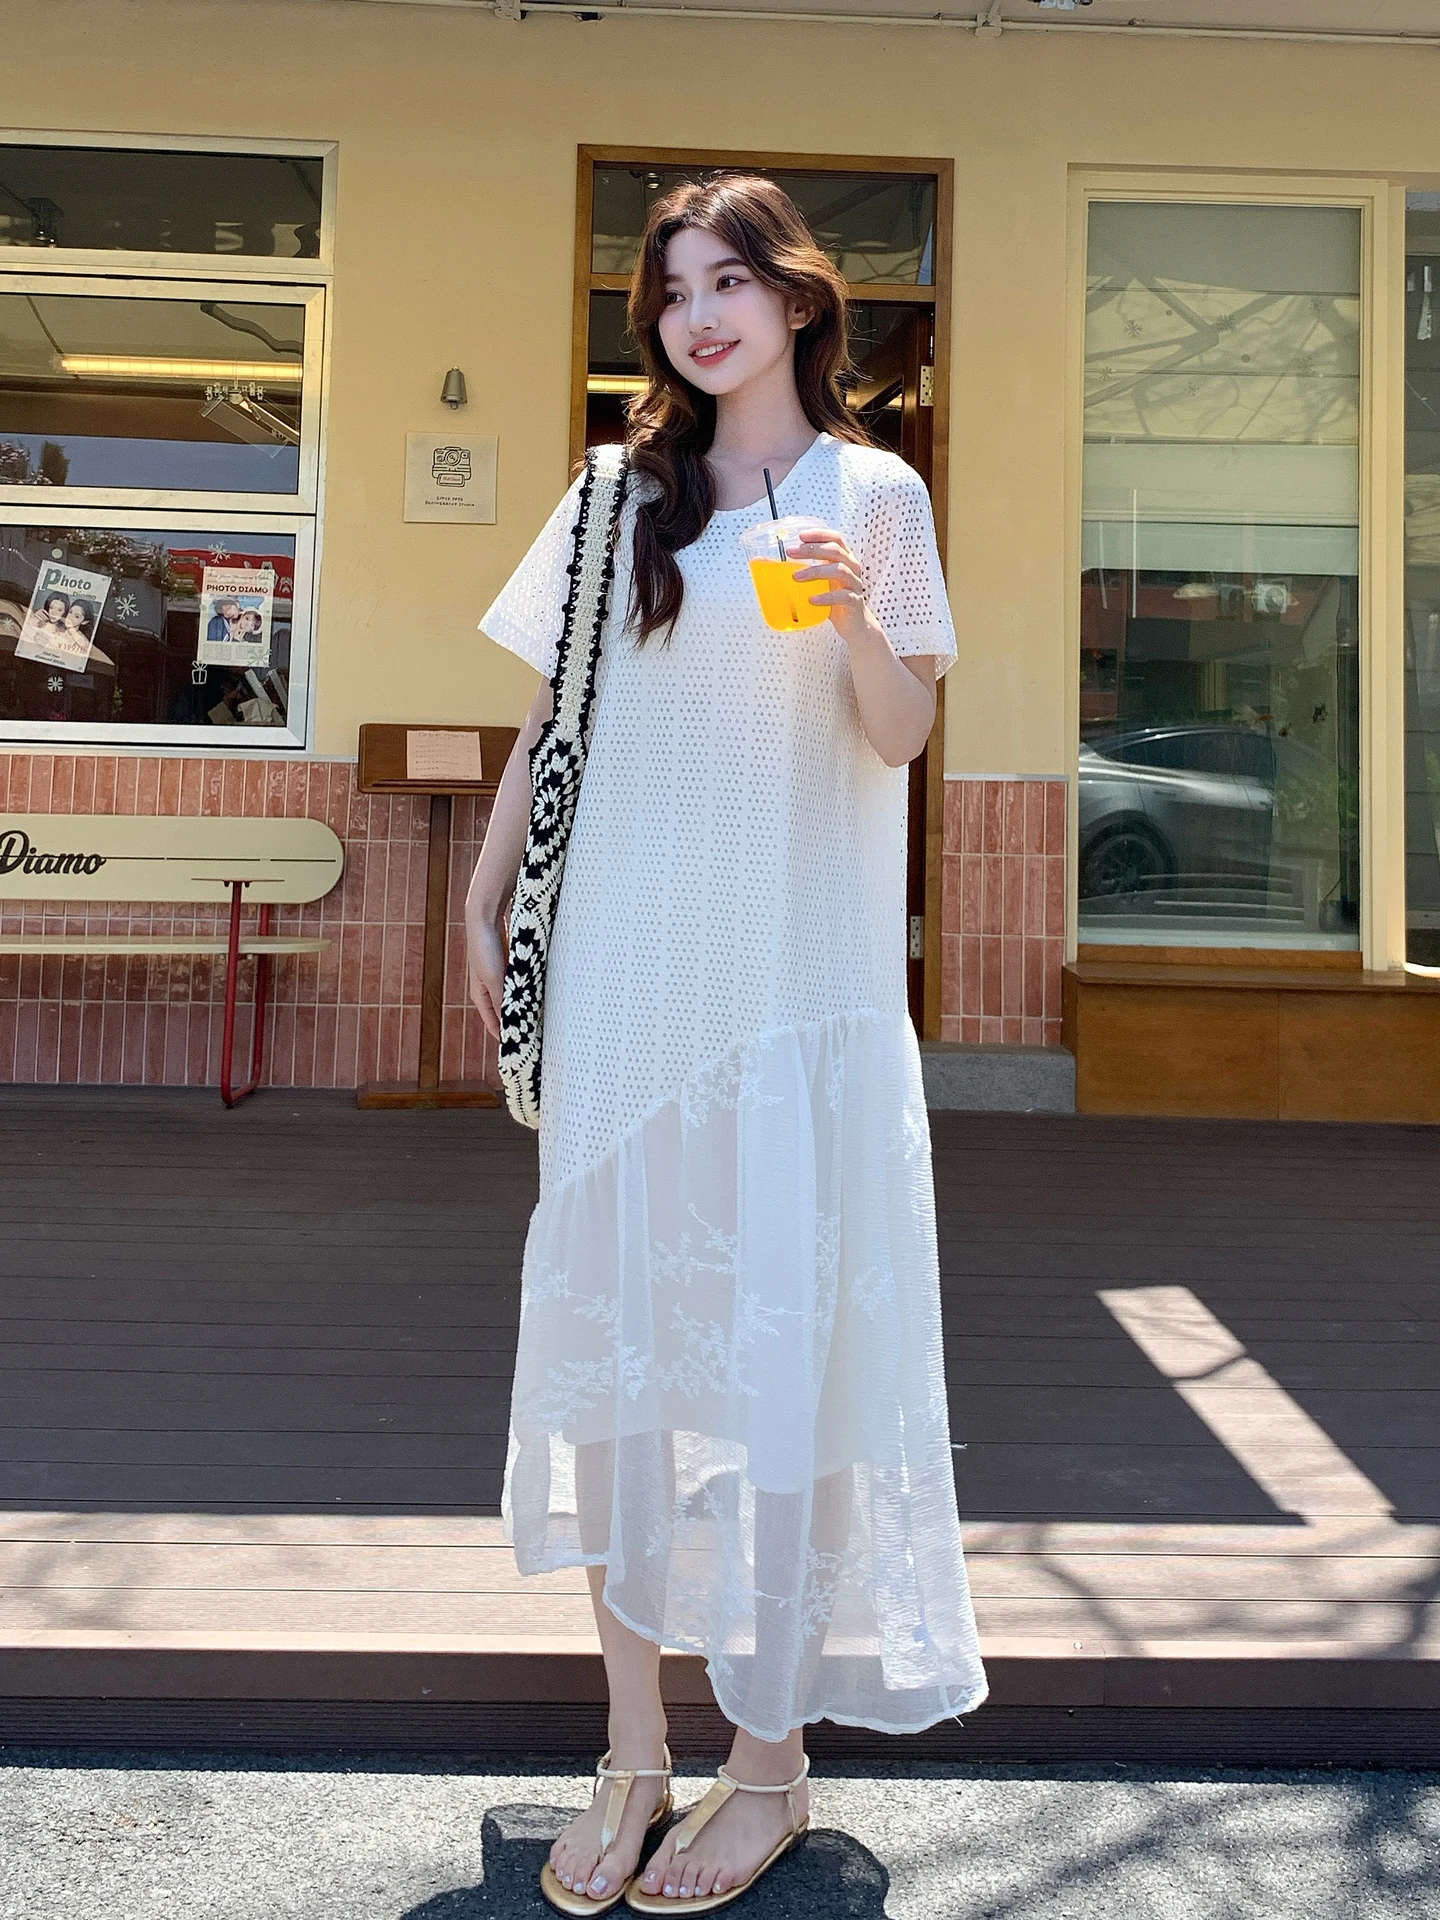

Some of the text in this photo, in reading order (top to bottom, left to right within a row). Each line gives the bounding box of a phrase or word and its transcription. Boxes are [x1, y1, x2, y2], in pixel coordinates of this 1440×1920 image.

[206, 584, 269, 594] PHOTO DIAMO
[72, 591, 97, 601] Diamo
[0, 830, 107, 874] Diamo
